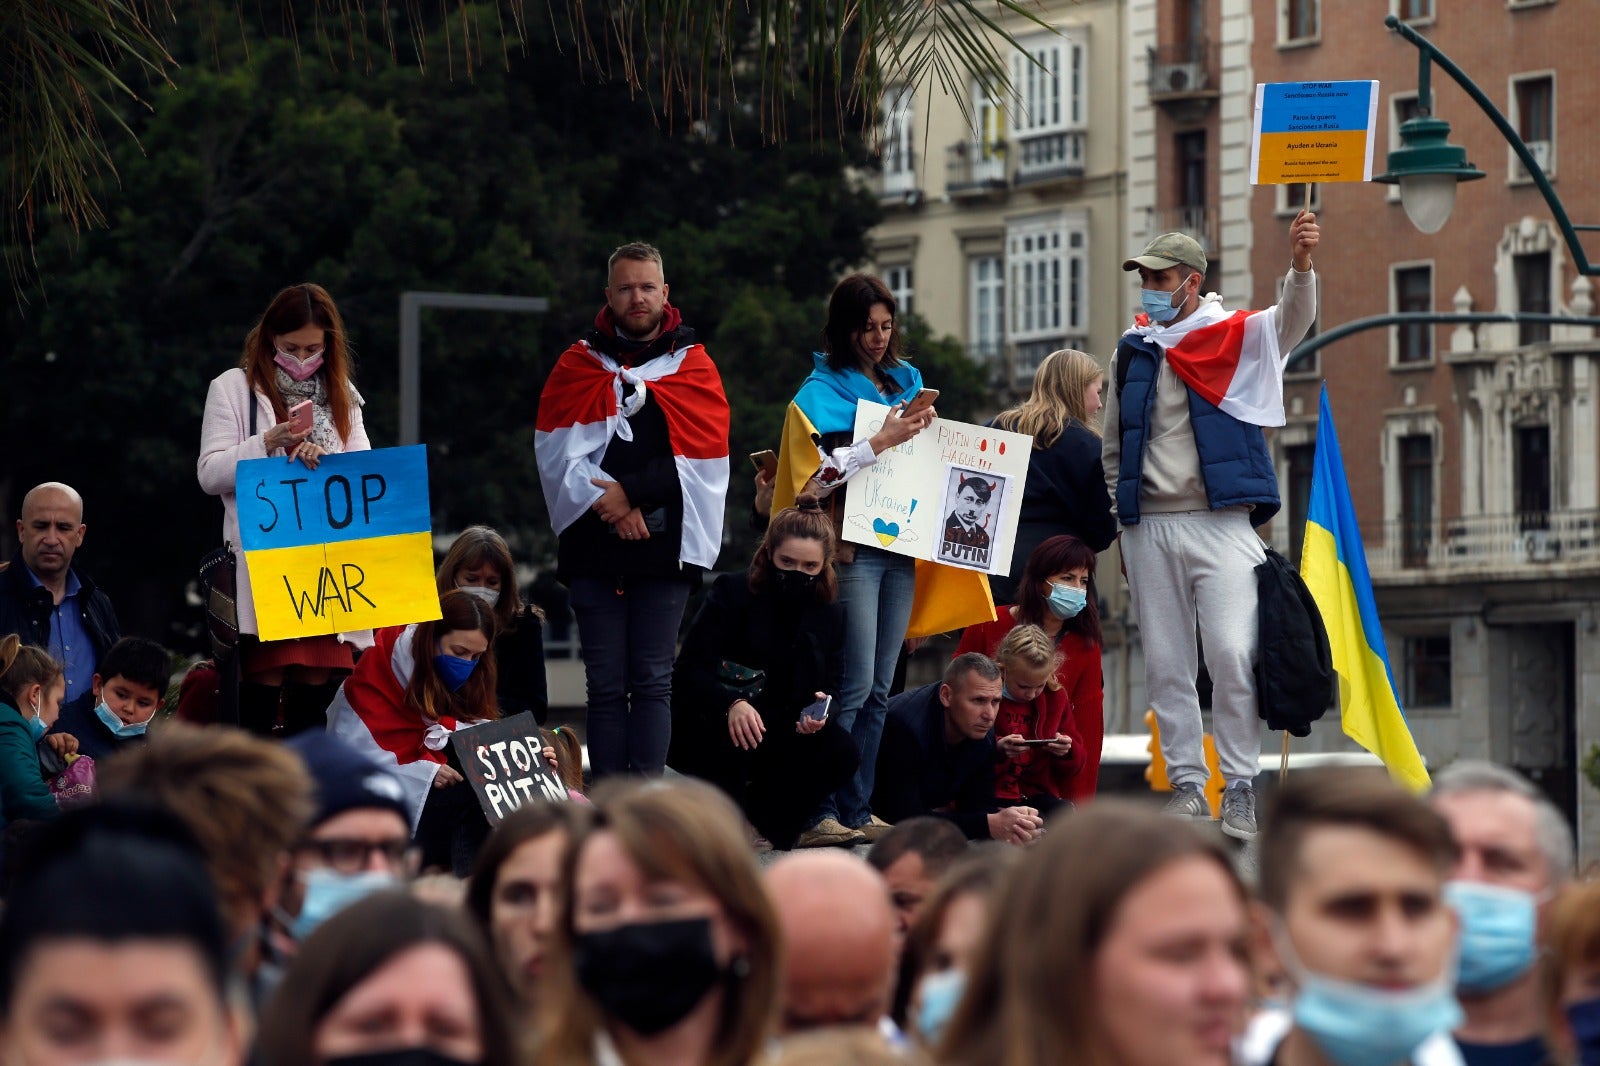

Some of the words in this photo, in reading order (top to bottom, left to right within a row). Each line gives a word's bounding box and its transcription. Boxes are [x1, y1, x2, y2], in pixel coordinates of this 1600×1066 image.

[1286, 142, 1310, 150] Ayuden
[938, 425, 969, 448] PUTIN
[974, 437, 987, 452] GO
[993, 438, 1006, 455] TO
[255, 473, 387, 533] STOP
[941, 541, 988, 563] PUTIN
[282, 563, 376, 622] WAR
[476, 736, 542, 781] STOP
